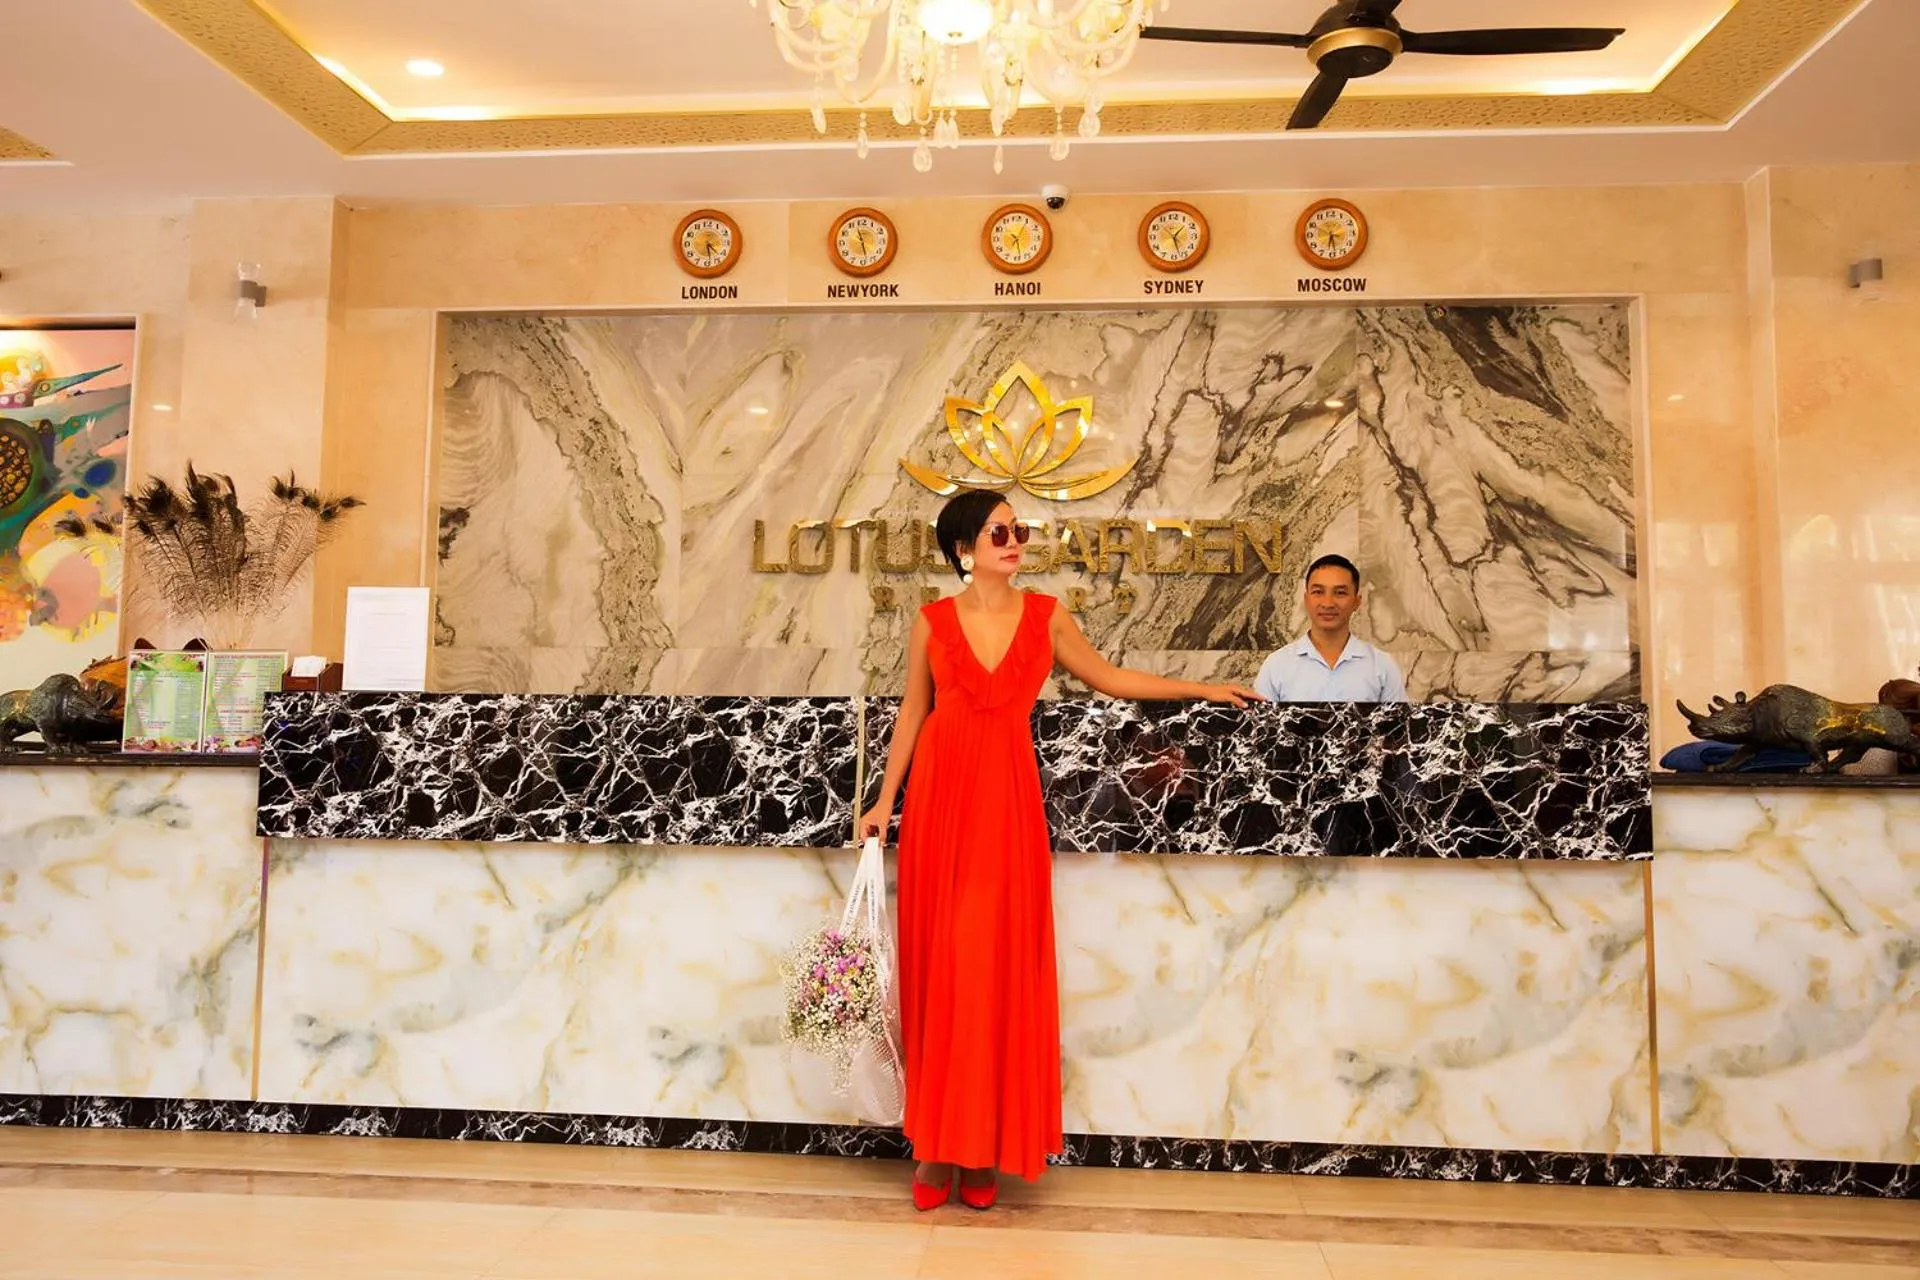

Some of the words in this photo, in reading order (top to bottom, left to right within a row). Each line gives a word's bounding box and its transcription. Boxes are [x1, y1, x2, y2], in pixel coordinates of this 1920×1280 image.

[681, 285, 738, 300] LONDON
[827, 283, 899, 298] NEWYORK
[994, 281, 1041, 296] HANOI
[1143, 279, 1203, 294] SYDNEY
[1297, 278, 1367, 292] MOSCOW
